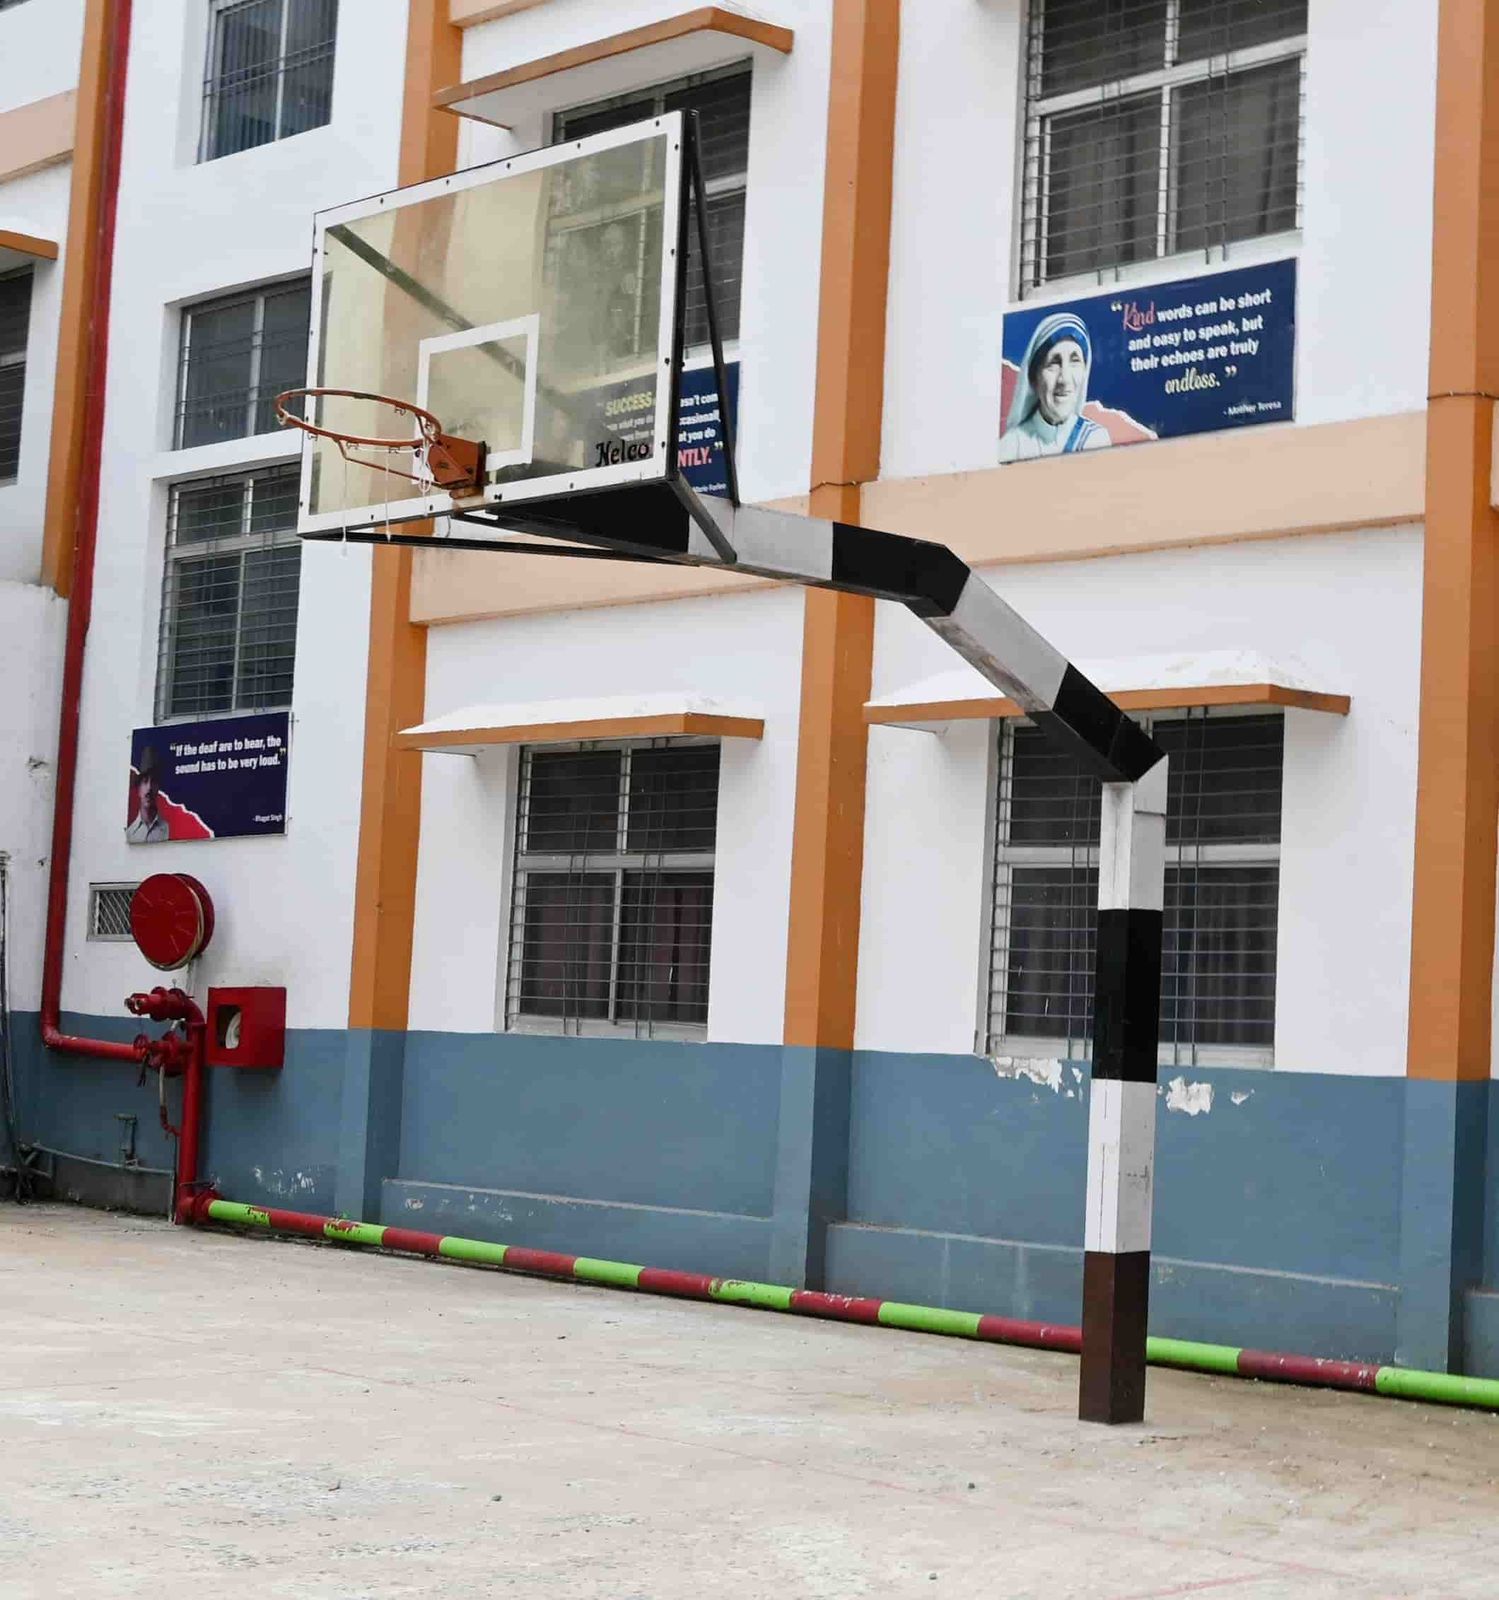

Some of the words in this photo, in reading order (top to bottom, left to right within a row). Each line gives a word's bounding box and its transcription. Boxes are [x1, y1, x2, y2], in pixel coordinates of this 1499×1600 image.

[1157, 304, 1194, 322] words
[1195, 301, 1218, 316] can
[1219, 296, 1236, 311] be
[1237, 288, 1272, 309] short
[1128, 334, 1151, 351] and
[1152, 332, 1182, 347] easy
[1182, 328, 1197, 342] to
[1198, 320, 1240, 341] speak,
[1242, 314, 1264, 332] but
[1130, 354, 1159, 372] their
[1161, 350, 1205, 367] echoes
[1206, 345, 1228, 359] are
[1230, 338, 1259, 355] truly
[687, 430, 704, 443] you
[703, 427, 716, 439] do
[595, 440, 649, 467] Nelco
[184, 744, 198, 756] the
[198, 741, 218, 755] deaf
[218, 742, 233, 752] are
[234, 739, 243, 751] to
[244, 737, 266, 750] hear,
[267, 735, 282, 748] the
[175, 761, 200, 775] sound
[201, 760, 216, 772] has
[217, 759, 227, 770] to
[228, 758, 239, 769] be
[240, 757, 258, 769] very
